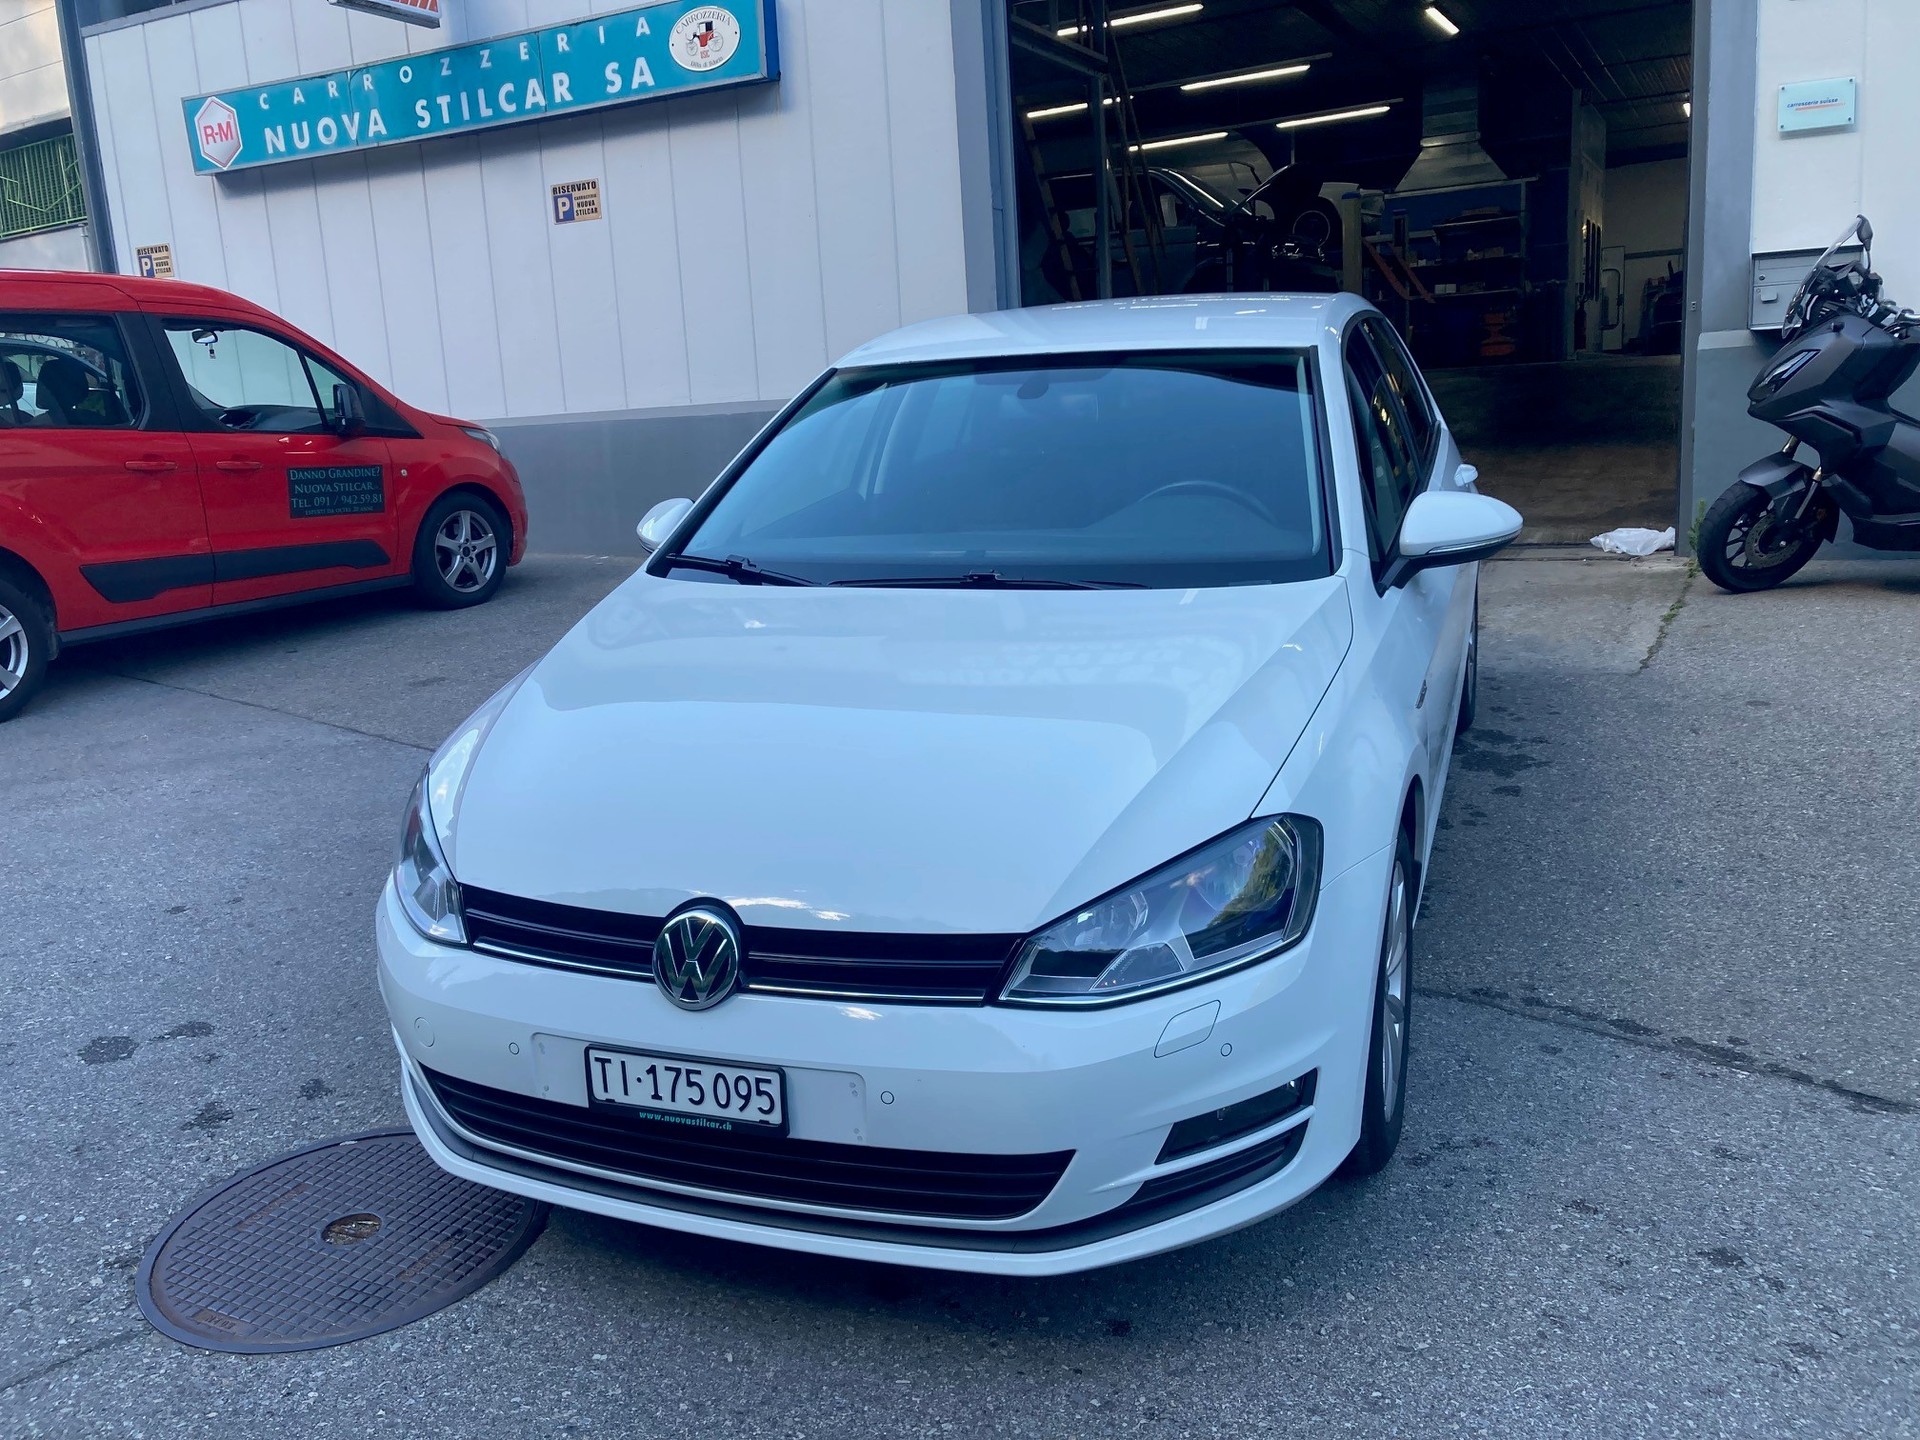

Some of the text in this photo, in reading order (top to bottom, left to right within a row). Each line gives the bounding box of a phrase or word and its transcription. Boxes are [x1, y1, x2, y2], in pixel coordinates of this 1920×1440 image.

[675, 11, 731, 34] CARROZZERIA
[259, 16, 651, 110] CARROZZERIA
[263, 56, 656, 154] NUOVA STILCAR SA
[552, 181, 597, 195] RISERVATO
[576, 200, 596, 208] NUOVA
[575, 207, 598, 217] STILCAR
[136, 245, 169, 256] RISERVATO
[290, 466, 381, 480] DANNO GRANDINE?
[314, 496, 330, 507] 091
[638, 1110, 733, 1131] www.nuovastilcar.ch
